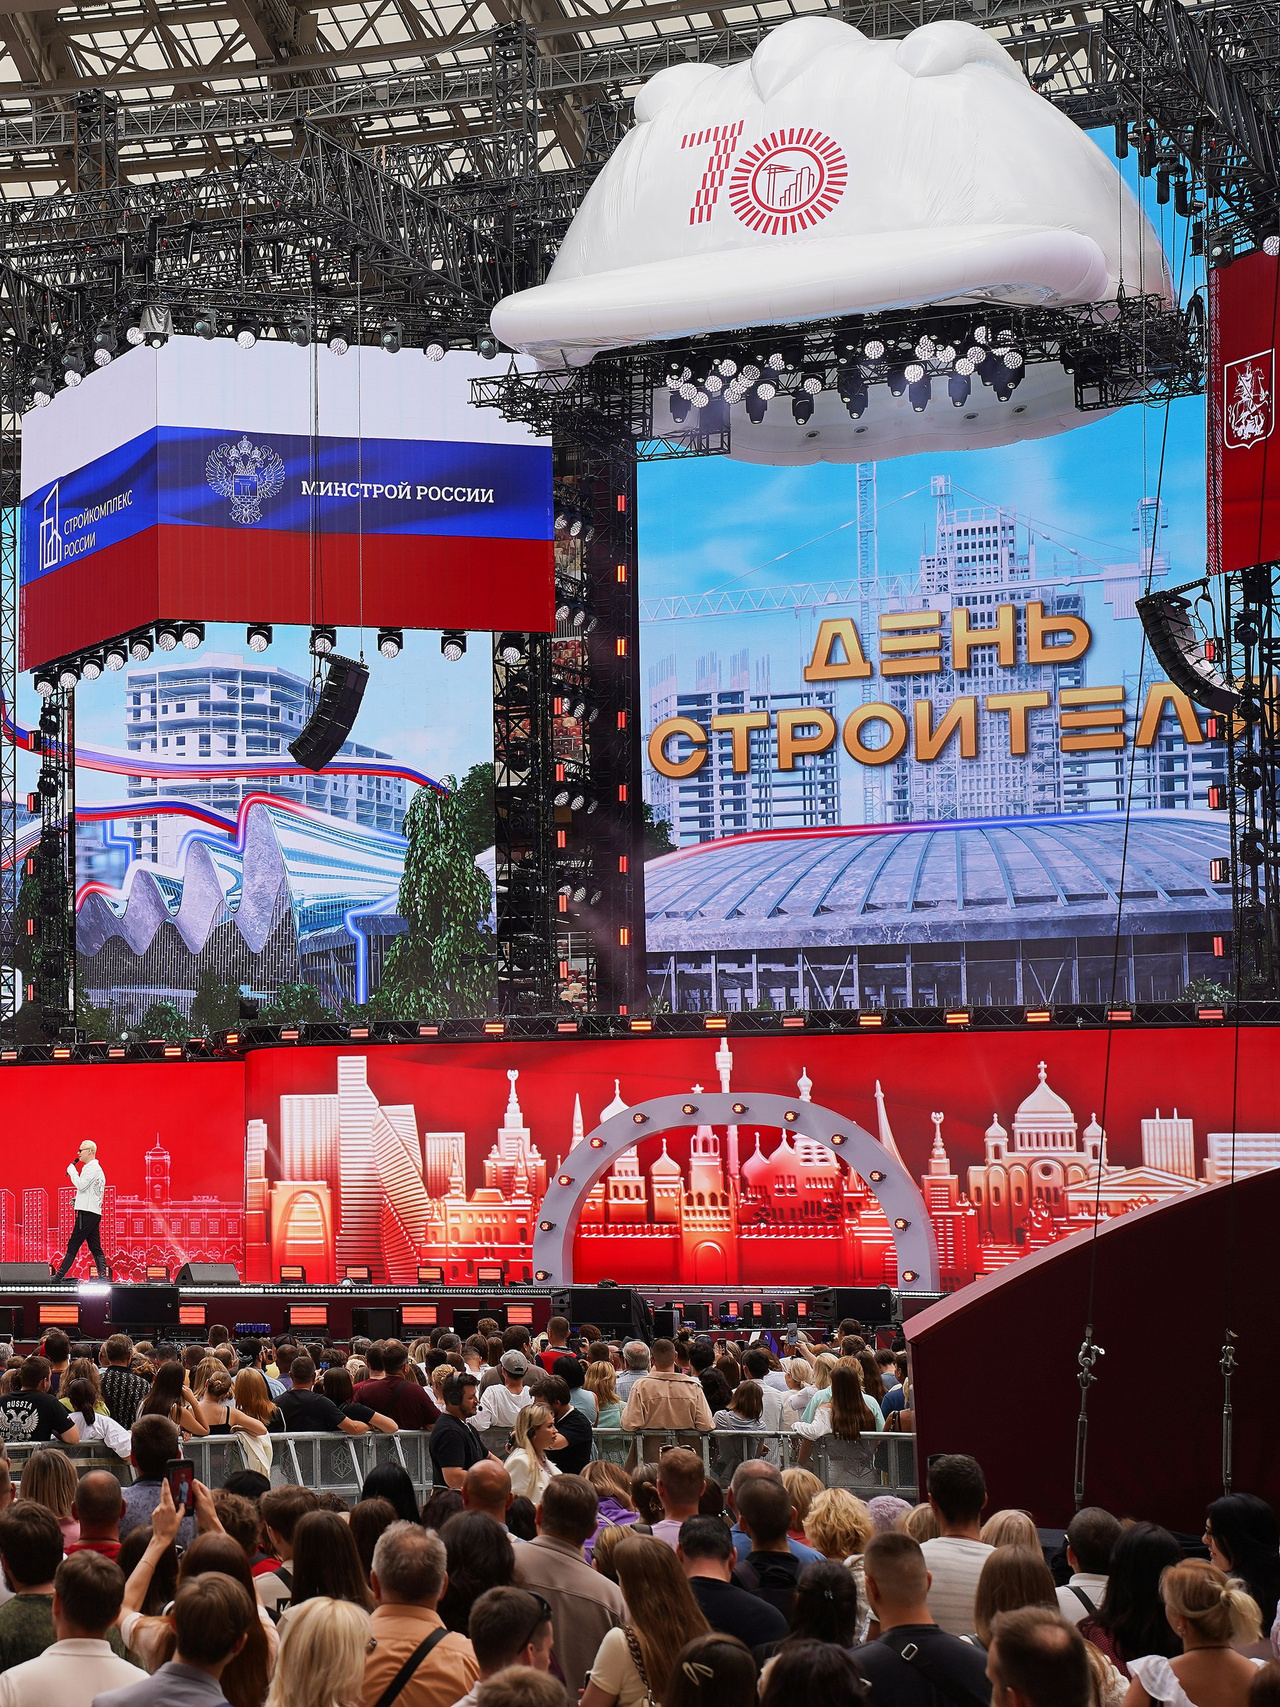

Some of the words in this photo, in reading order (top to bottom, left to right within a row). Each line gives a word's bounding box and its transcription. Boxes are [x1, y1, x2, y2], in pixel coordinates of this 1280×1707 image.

[301, 480, 412, 500] МИНСТРОЙ
[416, 485, 495, 503] РОССИИ
[63, 489, 133, 535] СТРОЙКОМПЛЕКС
[64, 531, 96, 559] РОССИИ
[804, 600, 1093, 683] ДЕНЬ
[6, 1400, 33, 1410] RUSSIA
